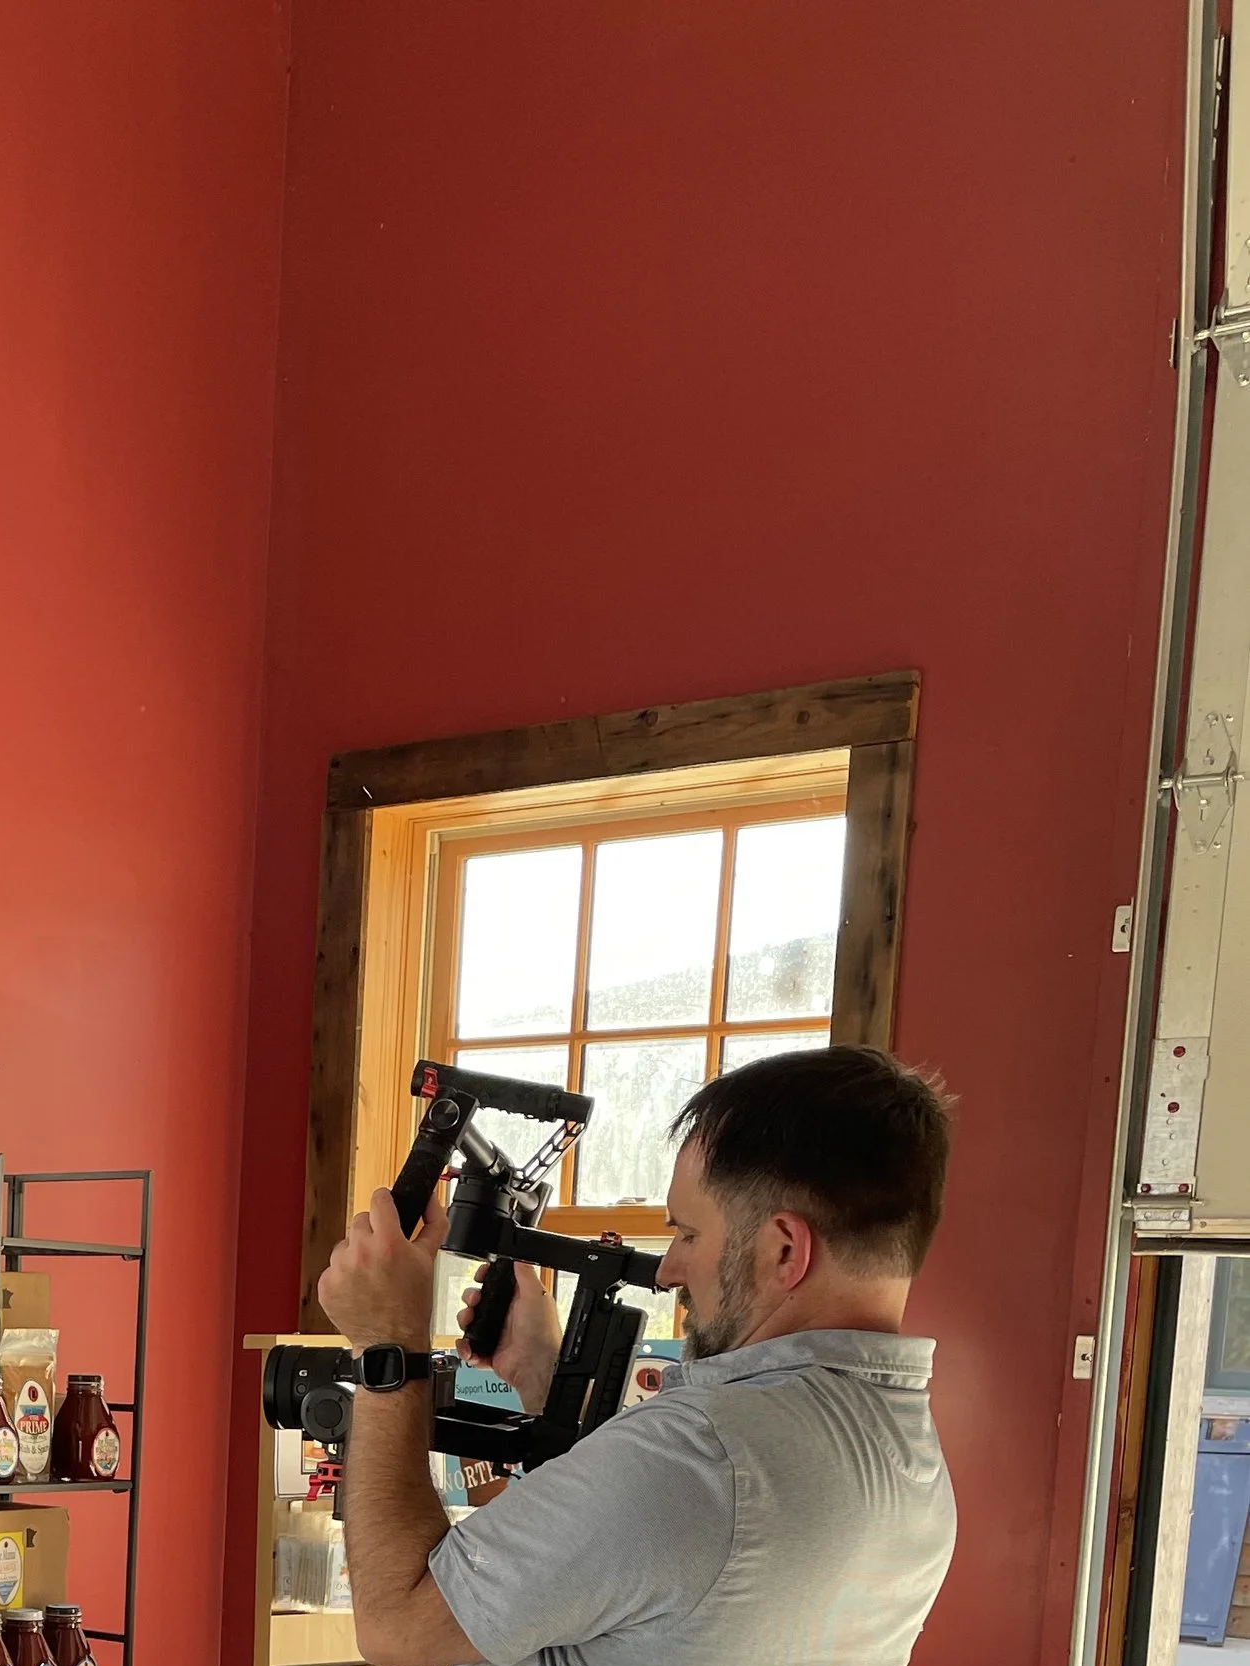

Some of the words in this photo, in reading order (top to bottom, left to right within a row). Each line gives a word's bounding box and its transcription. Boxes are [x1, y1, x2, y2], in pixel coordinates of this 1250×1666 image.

[299, 1369, 308, 1377] G
[456, 1385, 483, 1397] Support
[20, 1420, 48, 1434] PRIME
